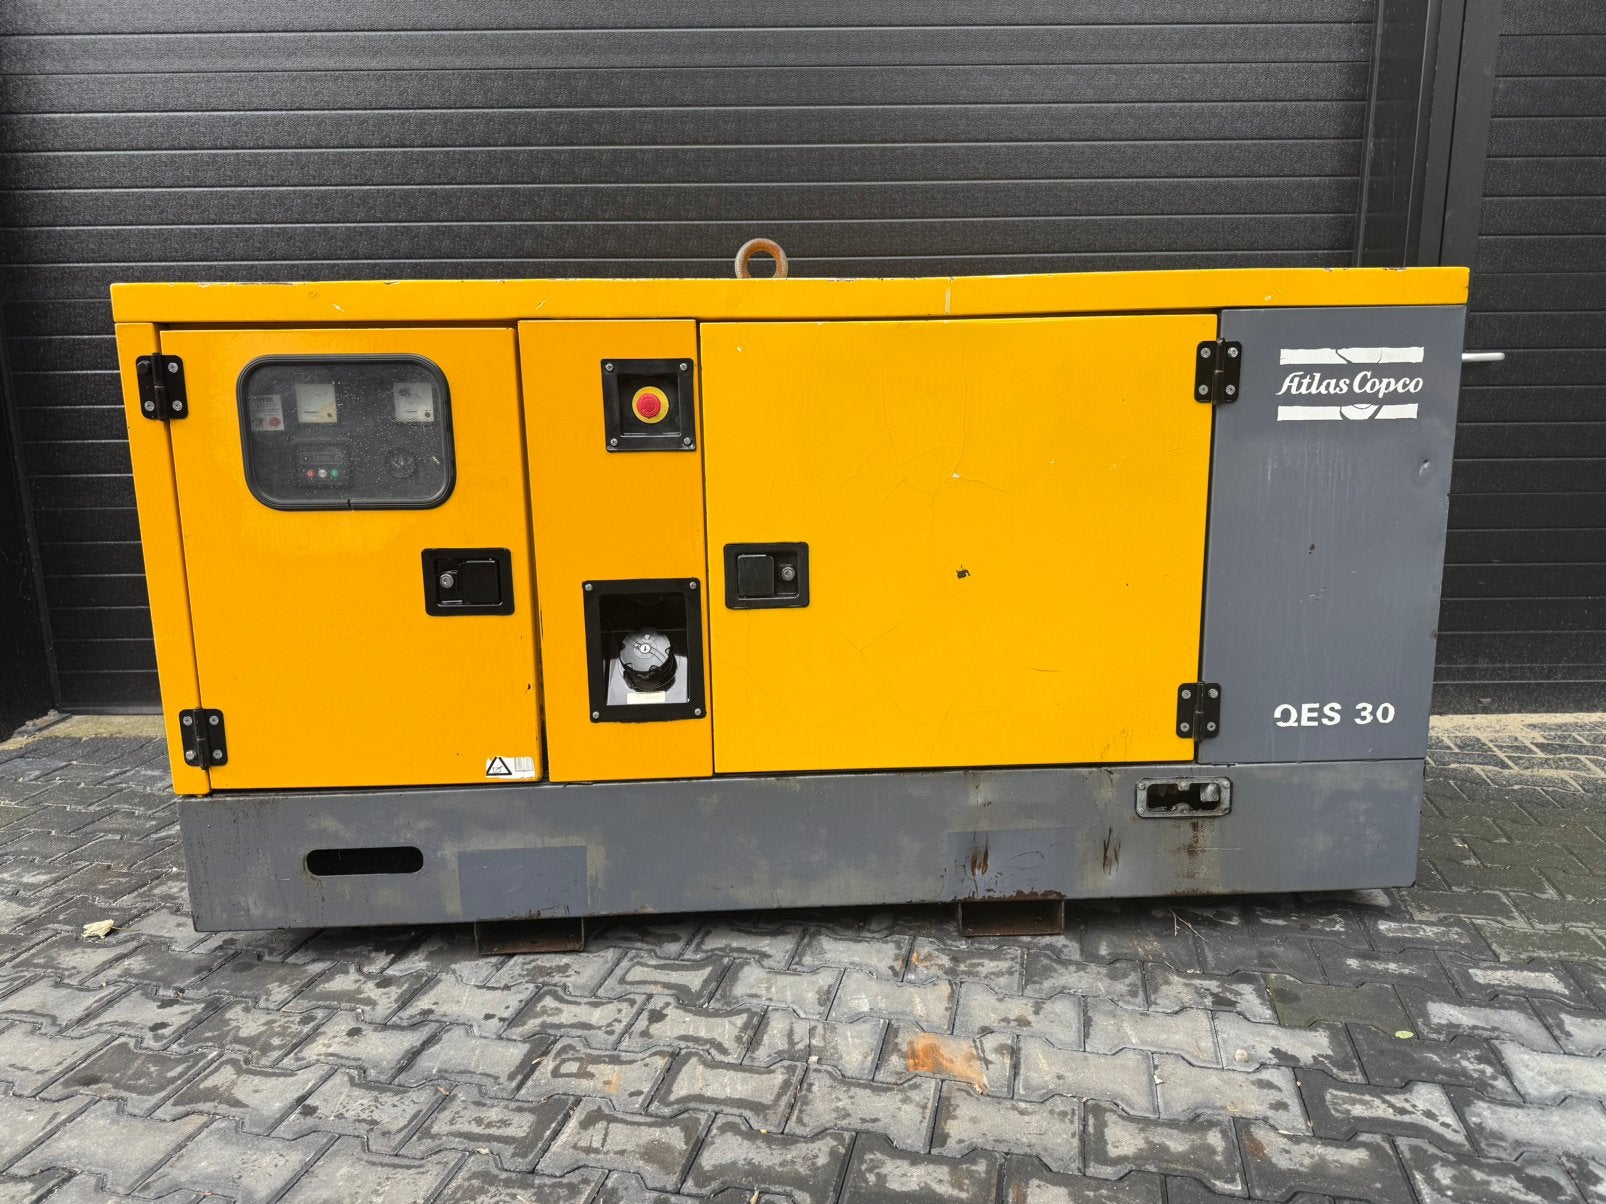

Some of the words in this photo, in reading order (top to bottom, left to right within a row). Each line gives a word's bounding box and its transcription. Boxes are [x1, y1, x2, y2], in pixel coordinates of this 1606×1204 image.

[1275, 371, 1350, 395] Atlas
[1352, 371, 1424, 398] Copco
[1273, 702, 1342, 727] QES
[1354, 702, 1396, 725] 30
